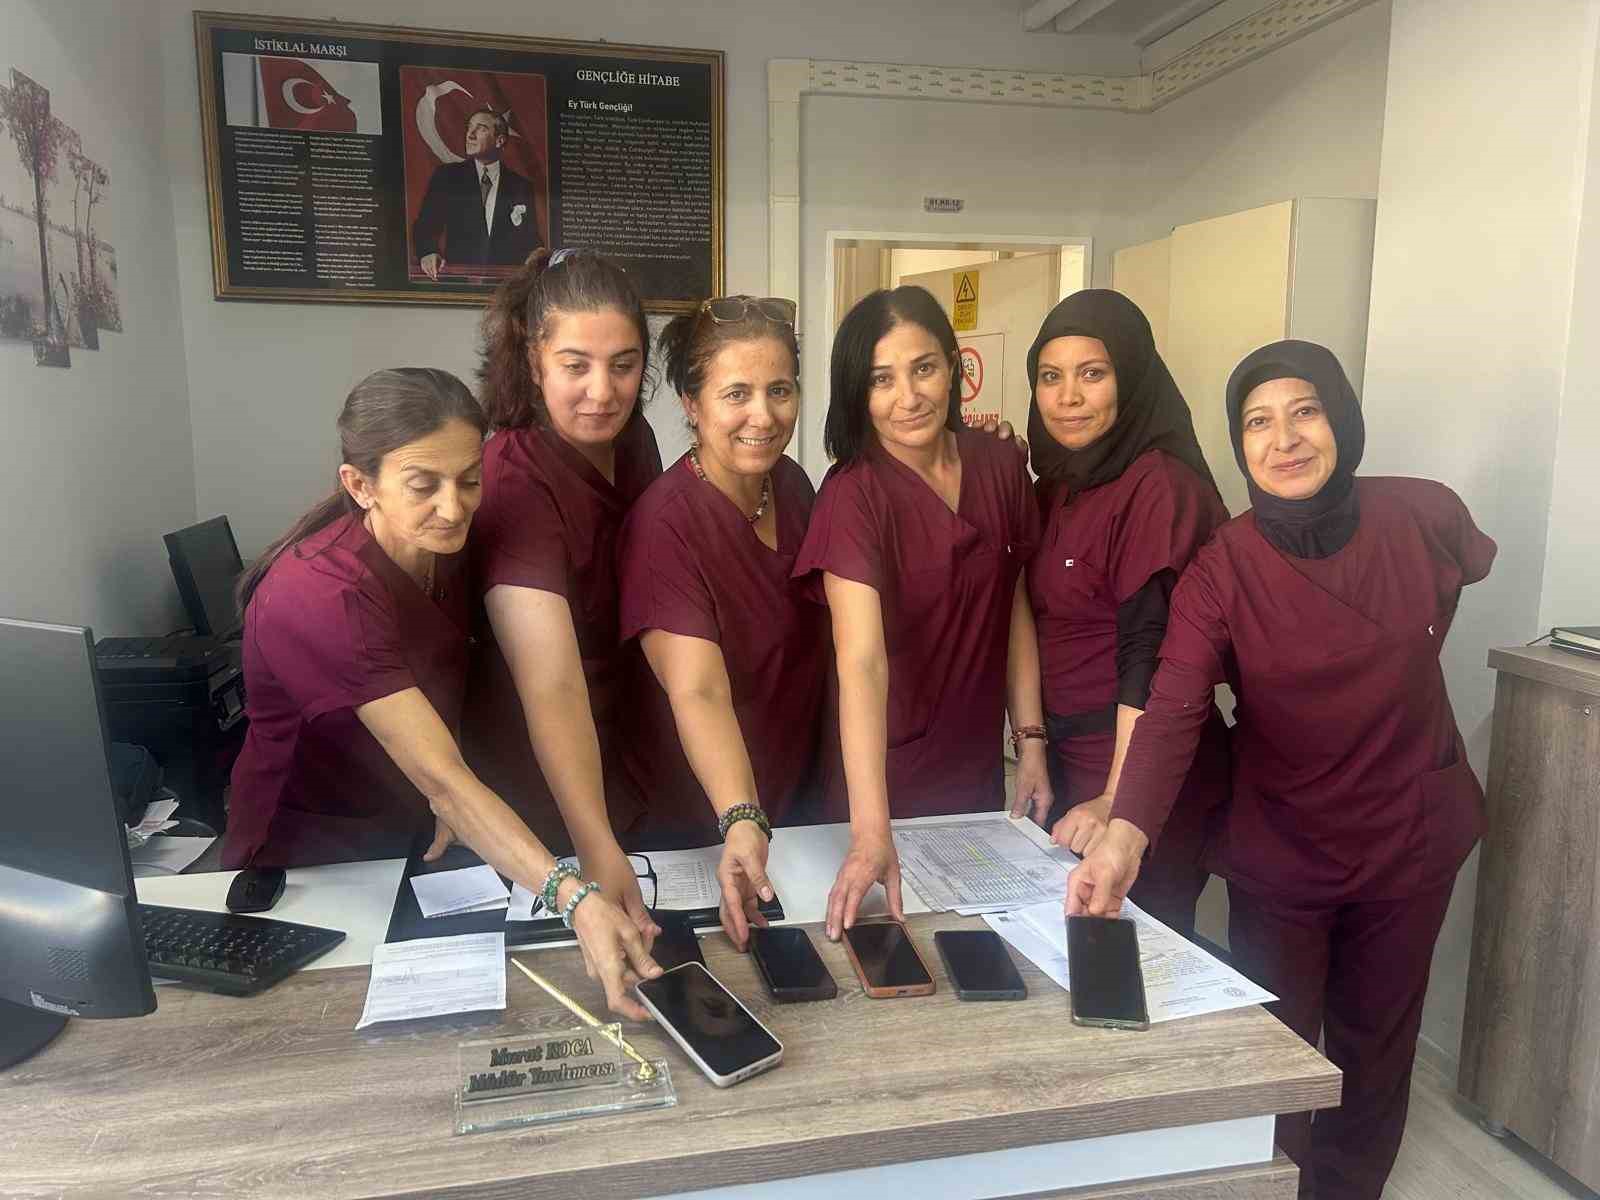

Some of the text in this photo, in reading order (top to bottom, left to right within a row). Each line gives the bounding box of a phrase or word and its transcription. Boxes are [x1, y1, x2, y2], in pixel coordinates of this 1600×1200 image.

[310, 43, 348, 57] MARŞI
[576, 70, 680, 87] GENÇLİĞE HİTABE
[568, 99, 578, 110] Ey
[580, 100, 597, 110] Türk
[546, 1038, 594, 1060] KOCA
